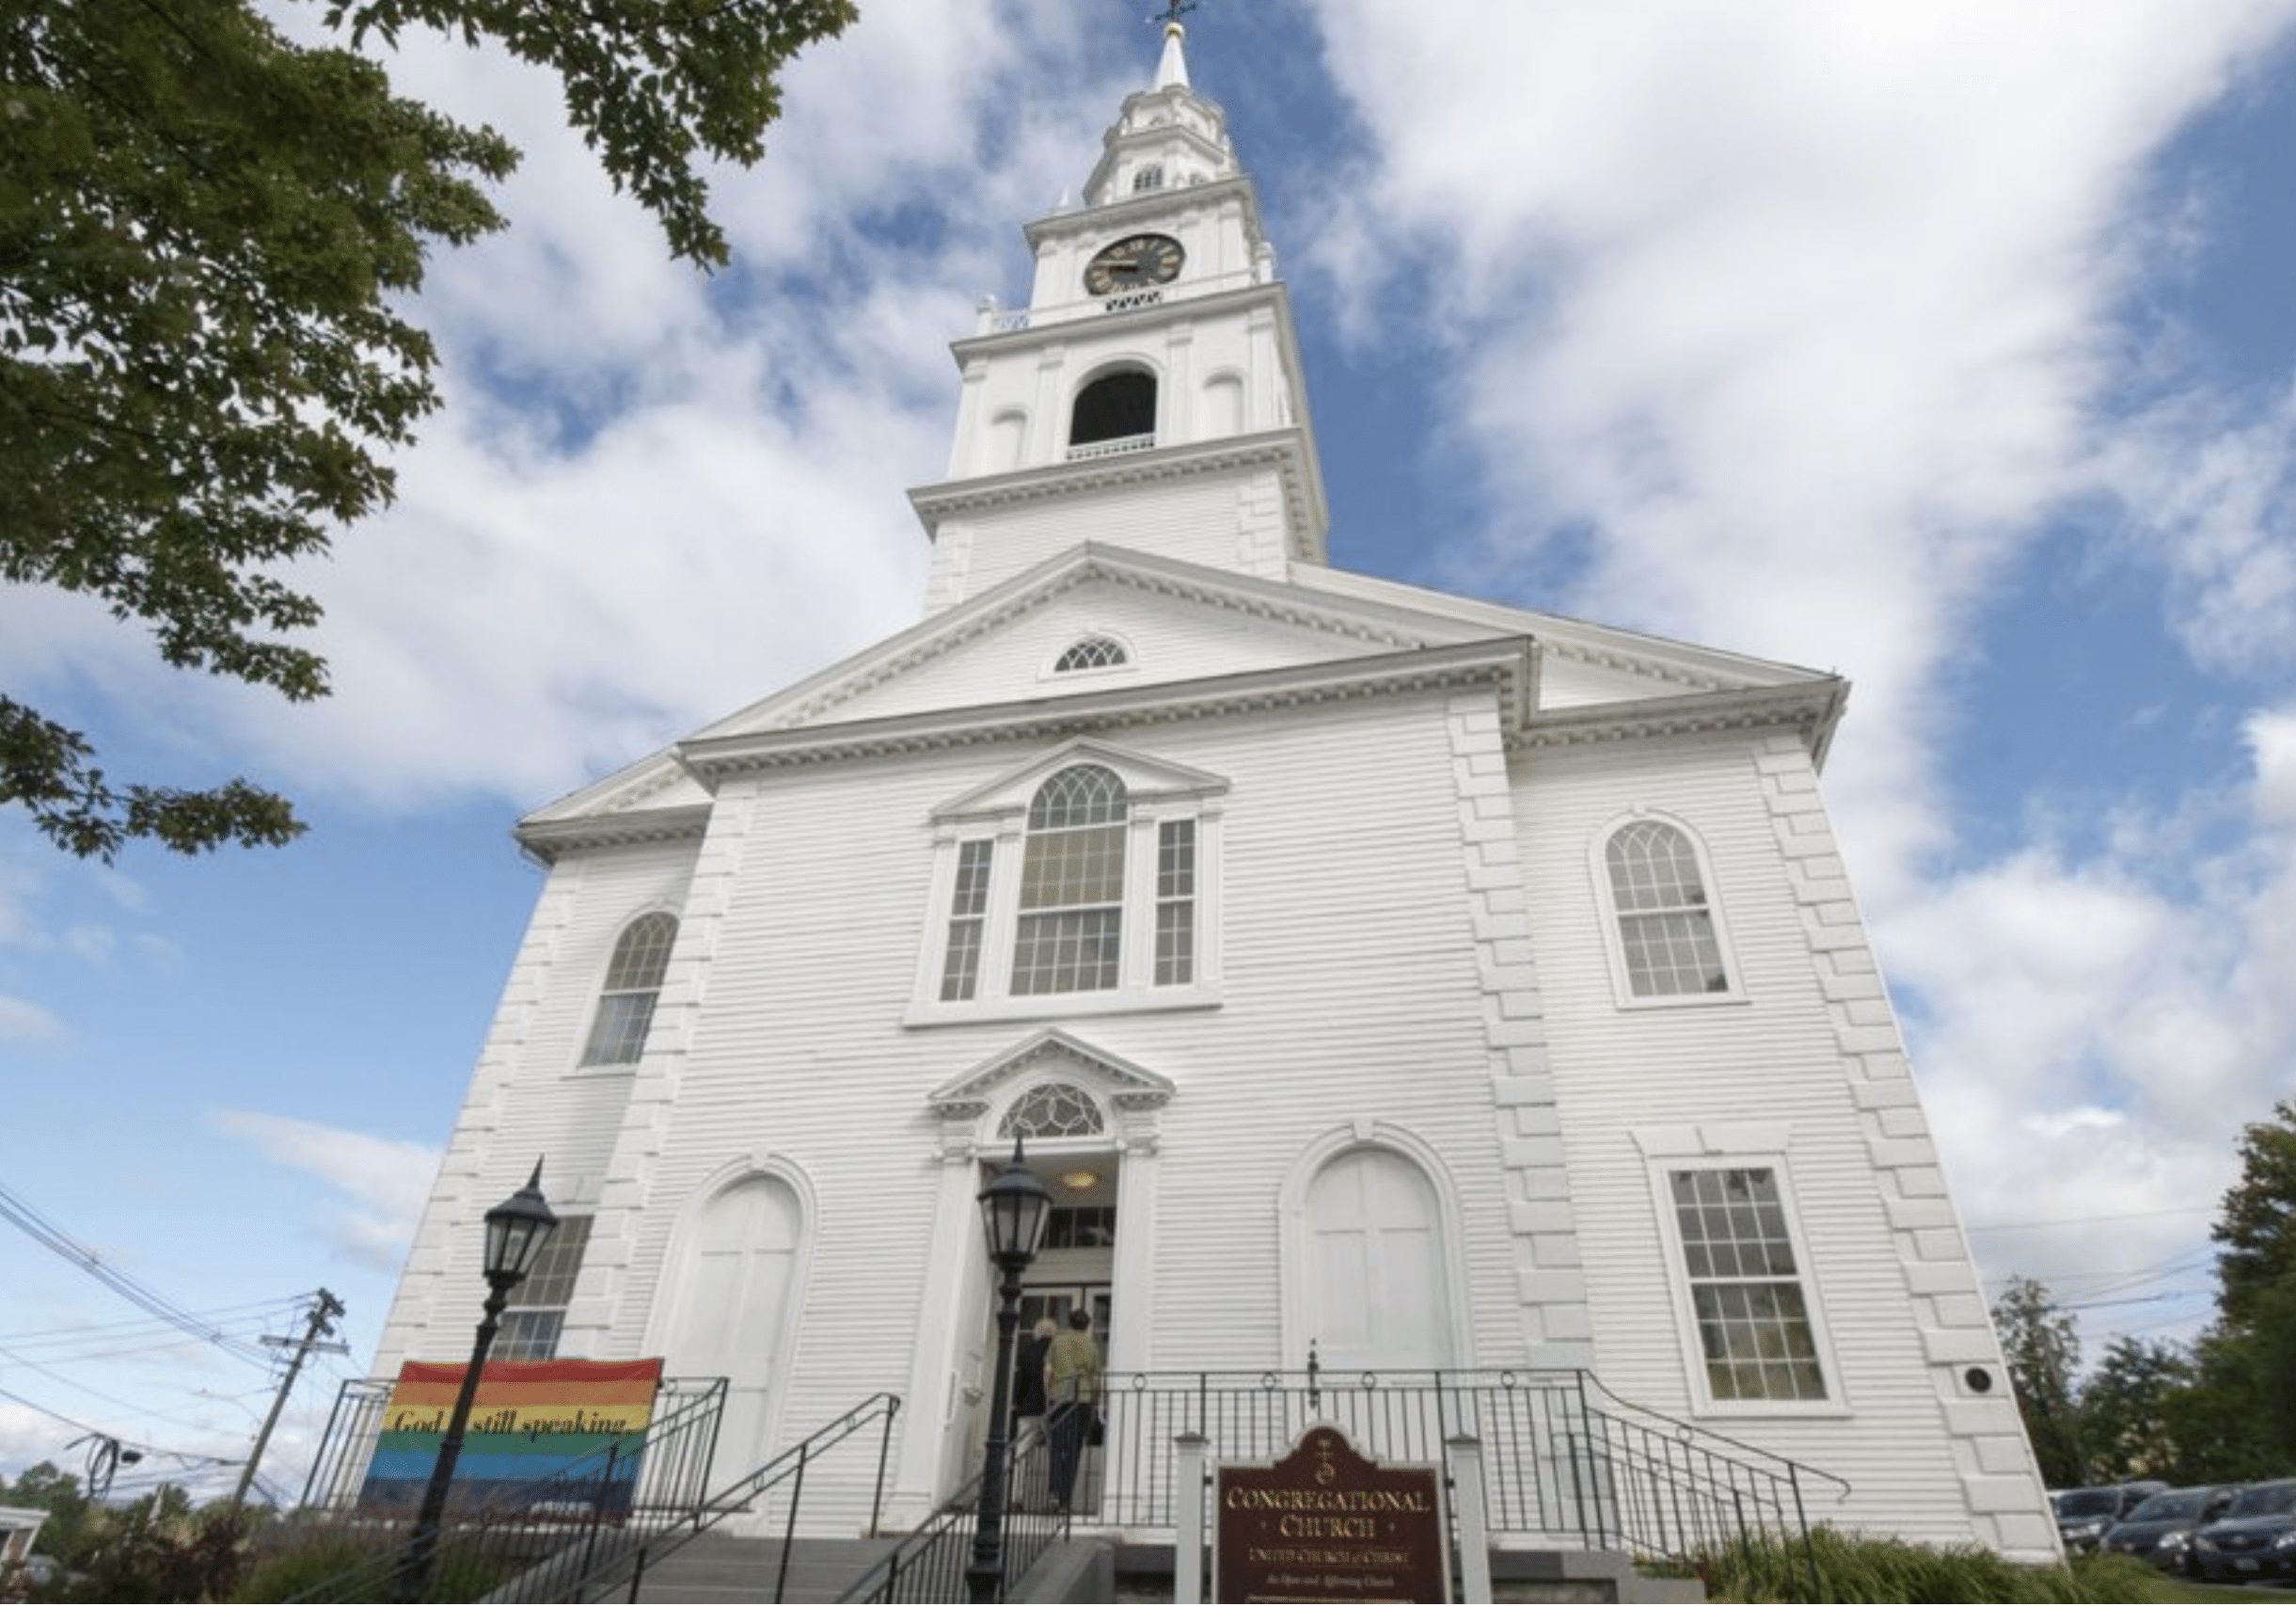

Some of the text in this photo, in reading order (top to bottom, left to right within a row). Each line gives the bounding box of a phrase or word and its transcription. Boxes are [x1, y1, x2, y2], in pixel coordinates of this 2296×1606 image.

[394, 1409, 444, 1434] God
[472, 1409, 517, 1435] still
[1227, 1486, 1431, 1512] CONGREGATIONAL
[1280, 1514, 1375, 1538] CHURCH
